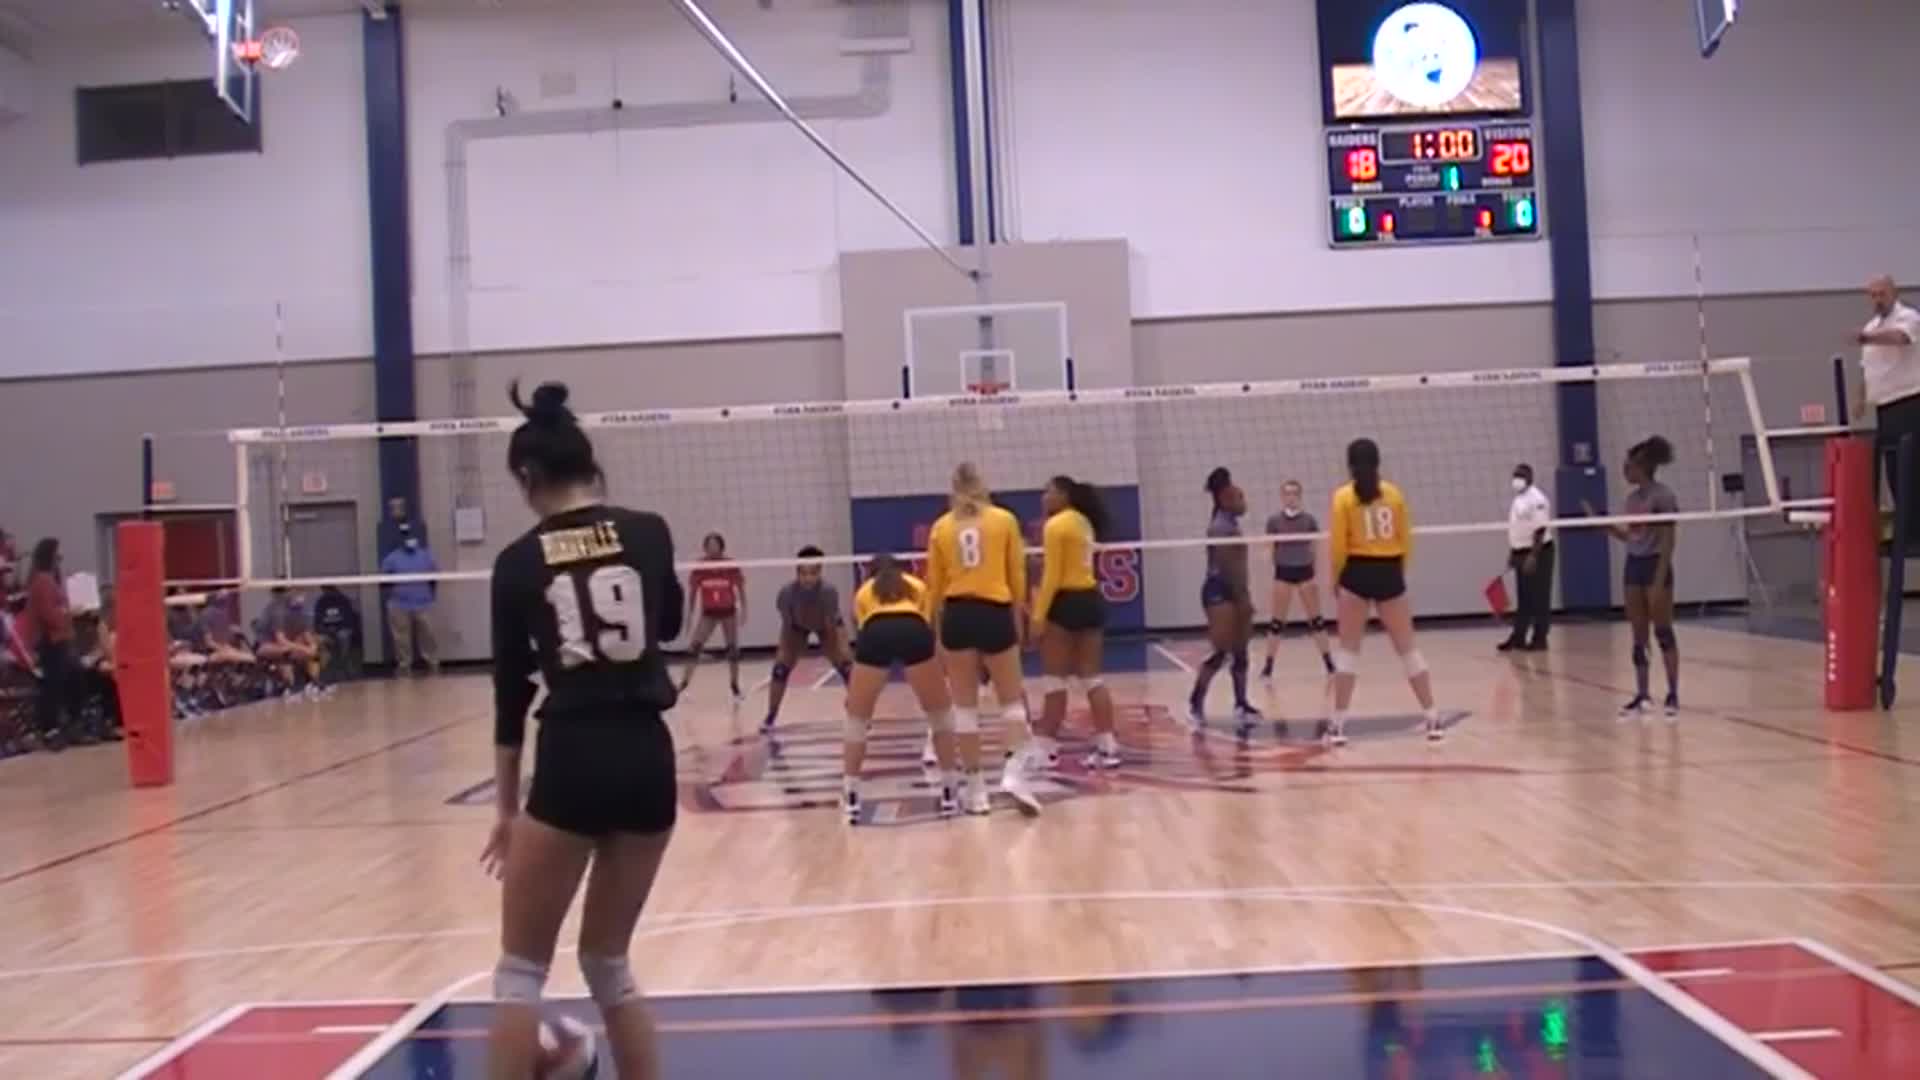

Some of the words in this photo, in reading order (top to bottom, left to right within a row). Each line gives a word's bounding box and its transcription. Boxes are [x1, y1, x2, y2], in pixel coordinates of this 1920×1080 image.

[1413, 130, 1473, 159] 1:00
[1493, 143, 1530, 174] 20
[1347, 149, 1377, 180] 18
[1361, 505, 1395, 542] 18
[539, 521, 623, 566] VILLE
[959, 526, 981, 568] 8
[545, 565, 646, 668] 19
